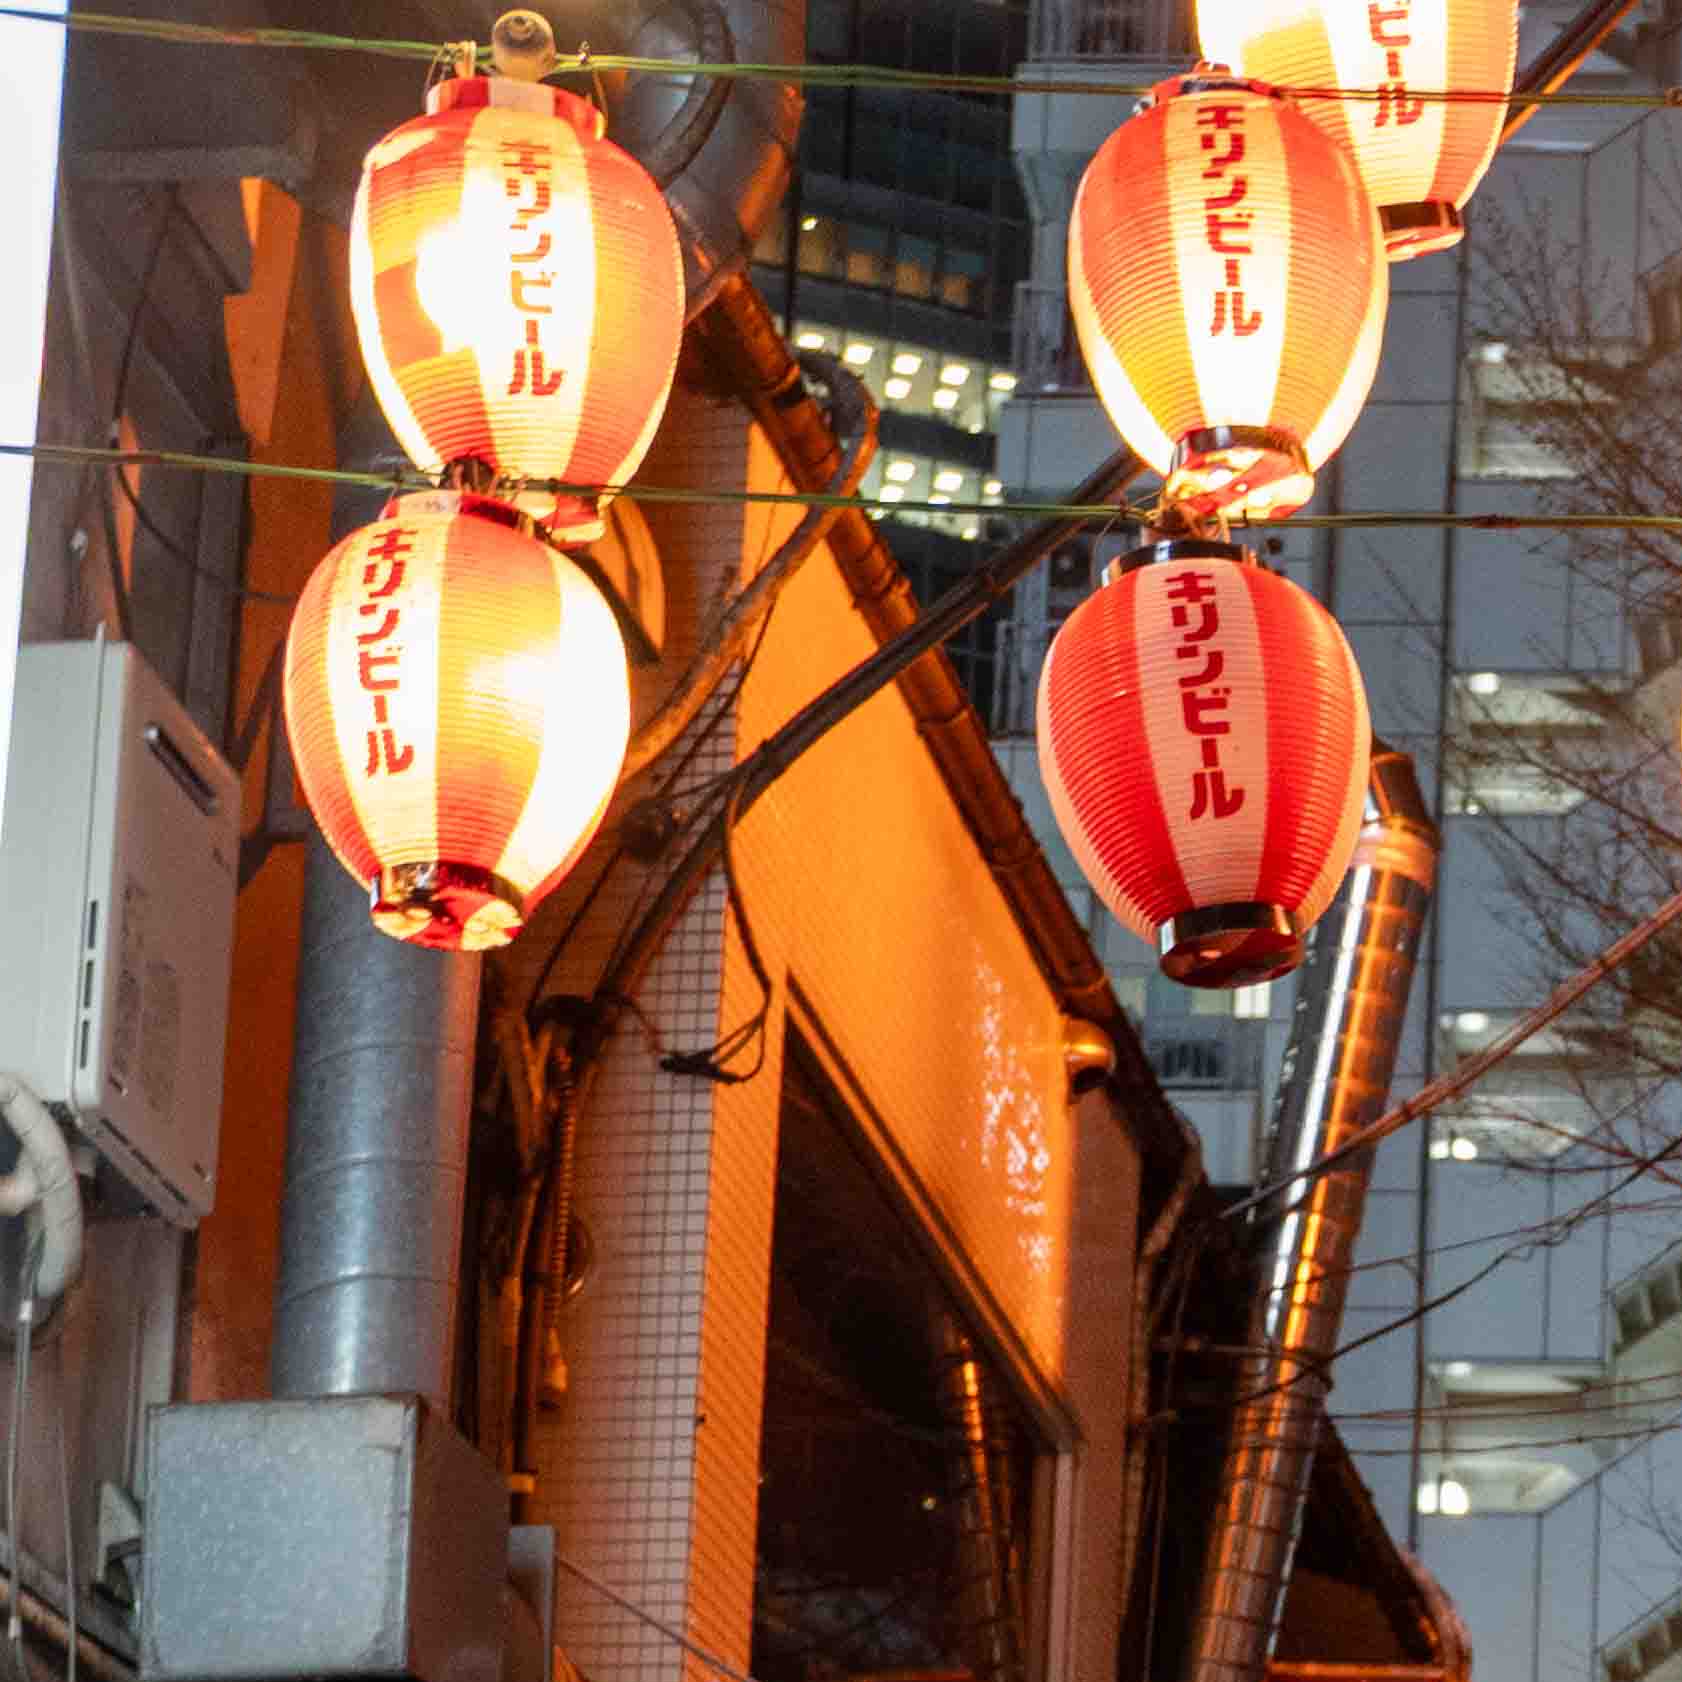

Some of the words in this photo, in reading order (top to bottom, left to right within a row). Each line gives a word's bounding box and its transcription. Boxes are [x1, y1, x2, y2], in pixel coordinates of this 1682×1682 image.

[502, 138, 563, 397] キリンビール
[1194, 104, 1263, 338] キリンビール
[355, 526, 415, 778] キリンビール
[1163, 570, 1246, 821] キリンビール
